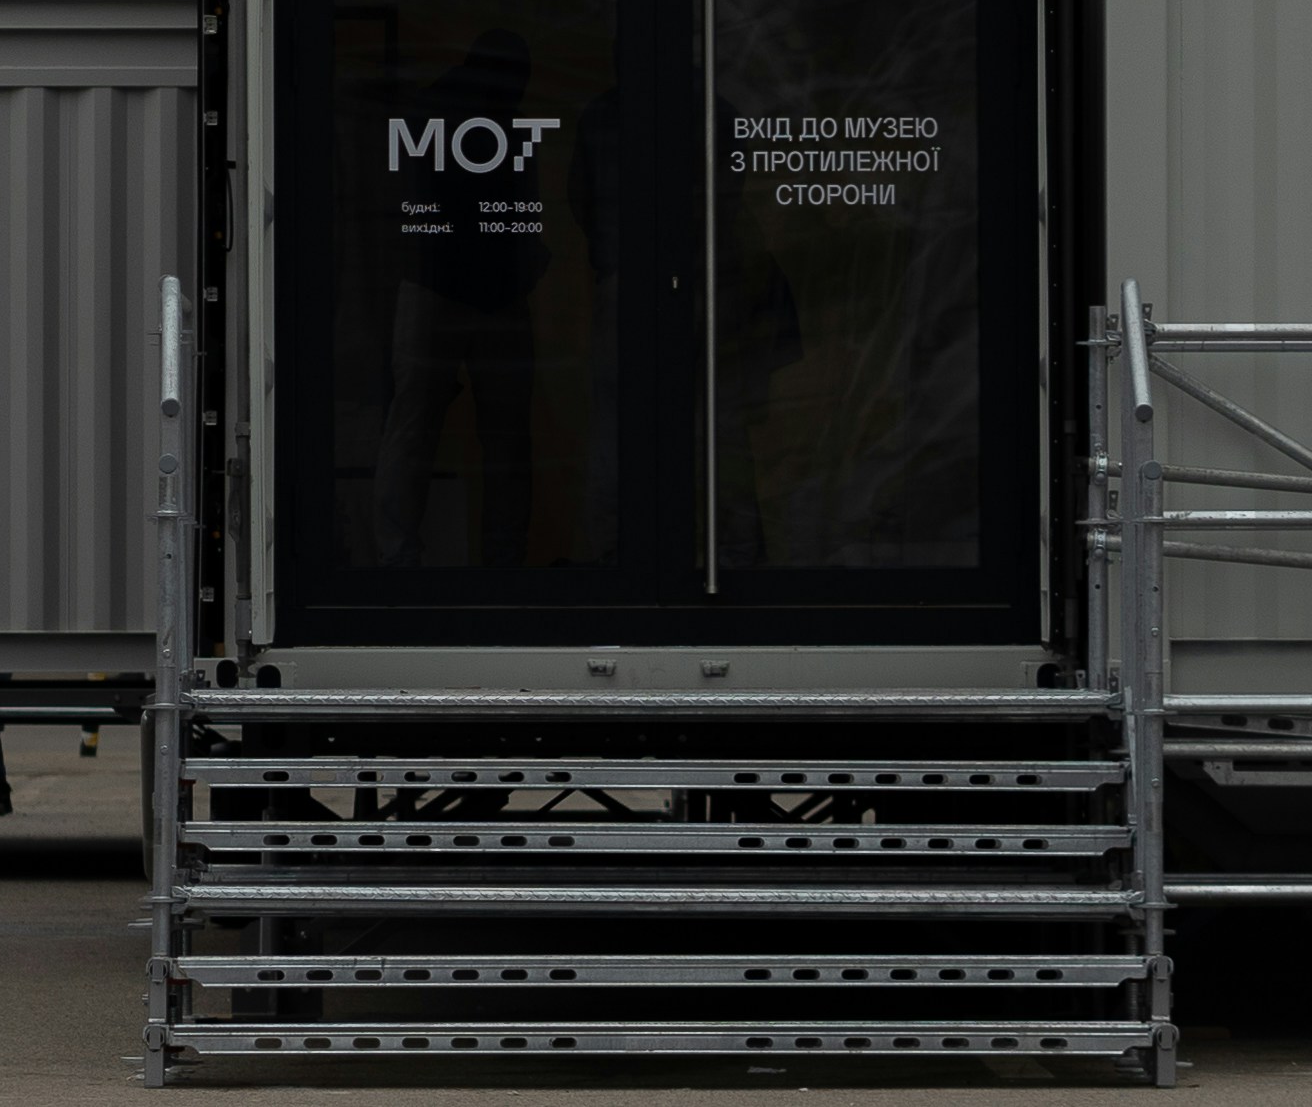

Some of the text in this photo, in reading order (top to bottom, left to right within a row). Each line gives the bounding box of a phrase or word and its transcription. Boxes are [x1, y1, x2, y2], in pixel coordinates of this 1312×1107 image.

[734, 116, 938, 142] ВХІД ДО МУЗЕЮ
[752, 146, 942, 172] ПРОТИЛЕЖНОЇ
[775, 183, 896, 206] СТОРОНИ
[401, 201, 440, 216] будні:
[401, 221, 453, 234] вихідні:
